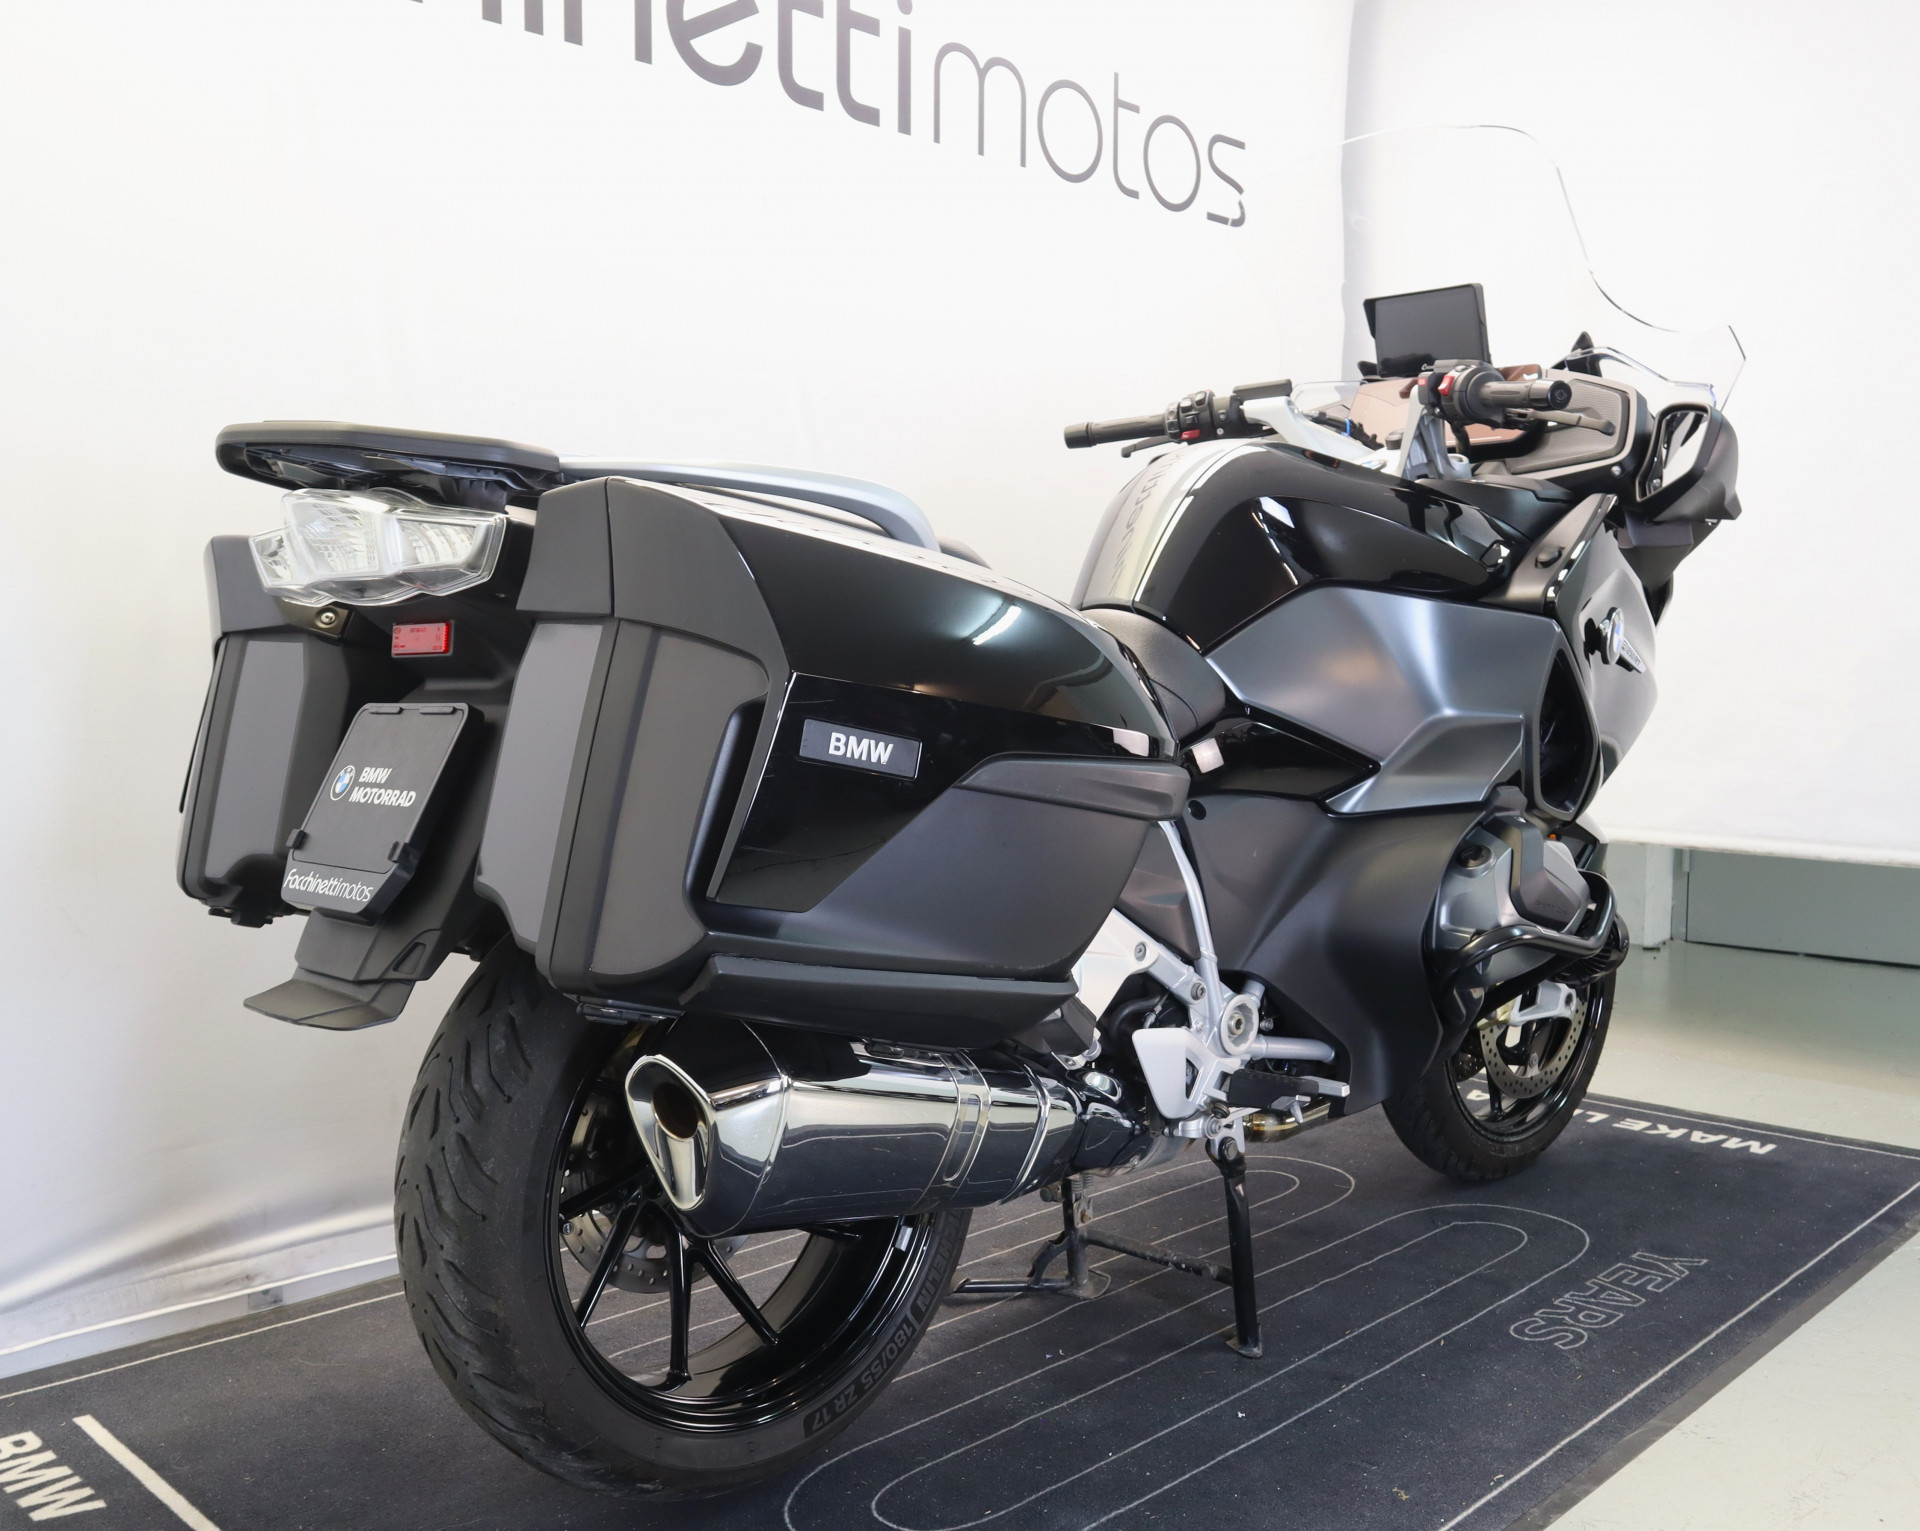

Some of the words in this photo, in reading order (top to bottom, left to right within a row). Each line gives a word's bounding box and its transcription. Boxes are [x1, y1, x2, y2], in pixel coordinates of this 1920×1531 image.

[828, 732, 894, 765] BMW
[359, 767, 392, 784] BMW
[349, 787, 416, 807] MOTORRAD
[283, 869, 374, 902] facchinettimotos
[1612, 1118, 1777, 1155] MAKE
[1510, 1252, 1708, 1350] YEARS
[861, 1324, 914, 1391] 180/55
[836, 1389, 859, 1416] ZR
[812, 1412, 832, 1431] 17
[0, 1430, 107, 1522] BMW
